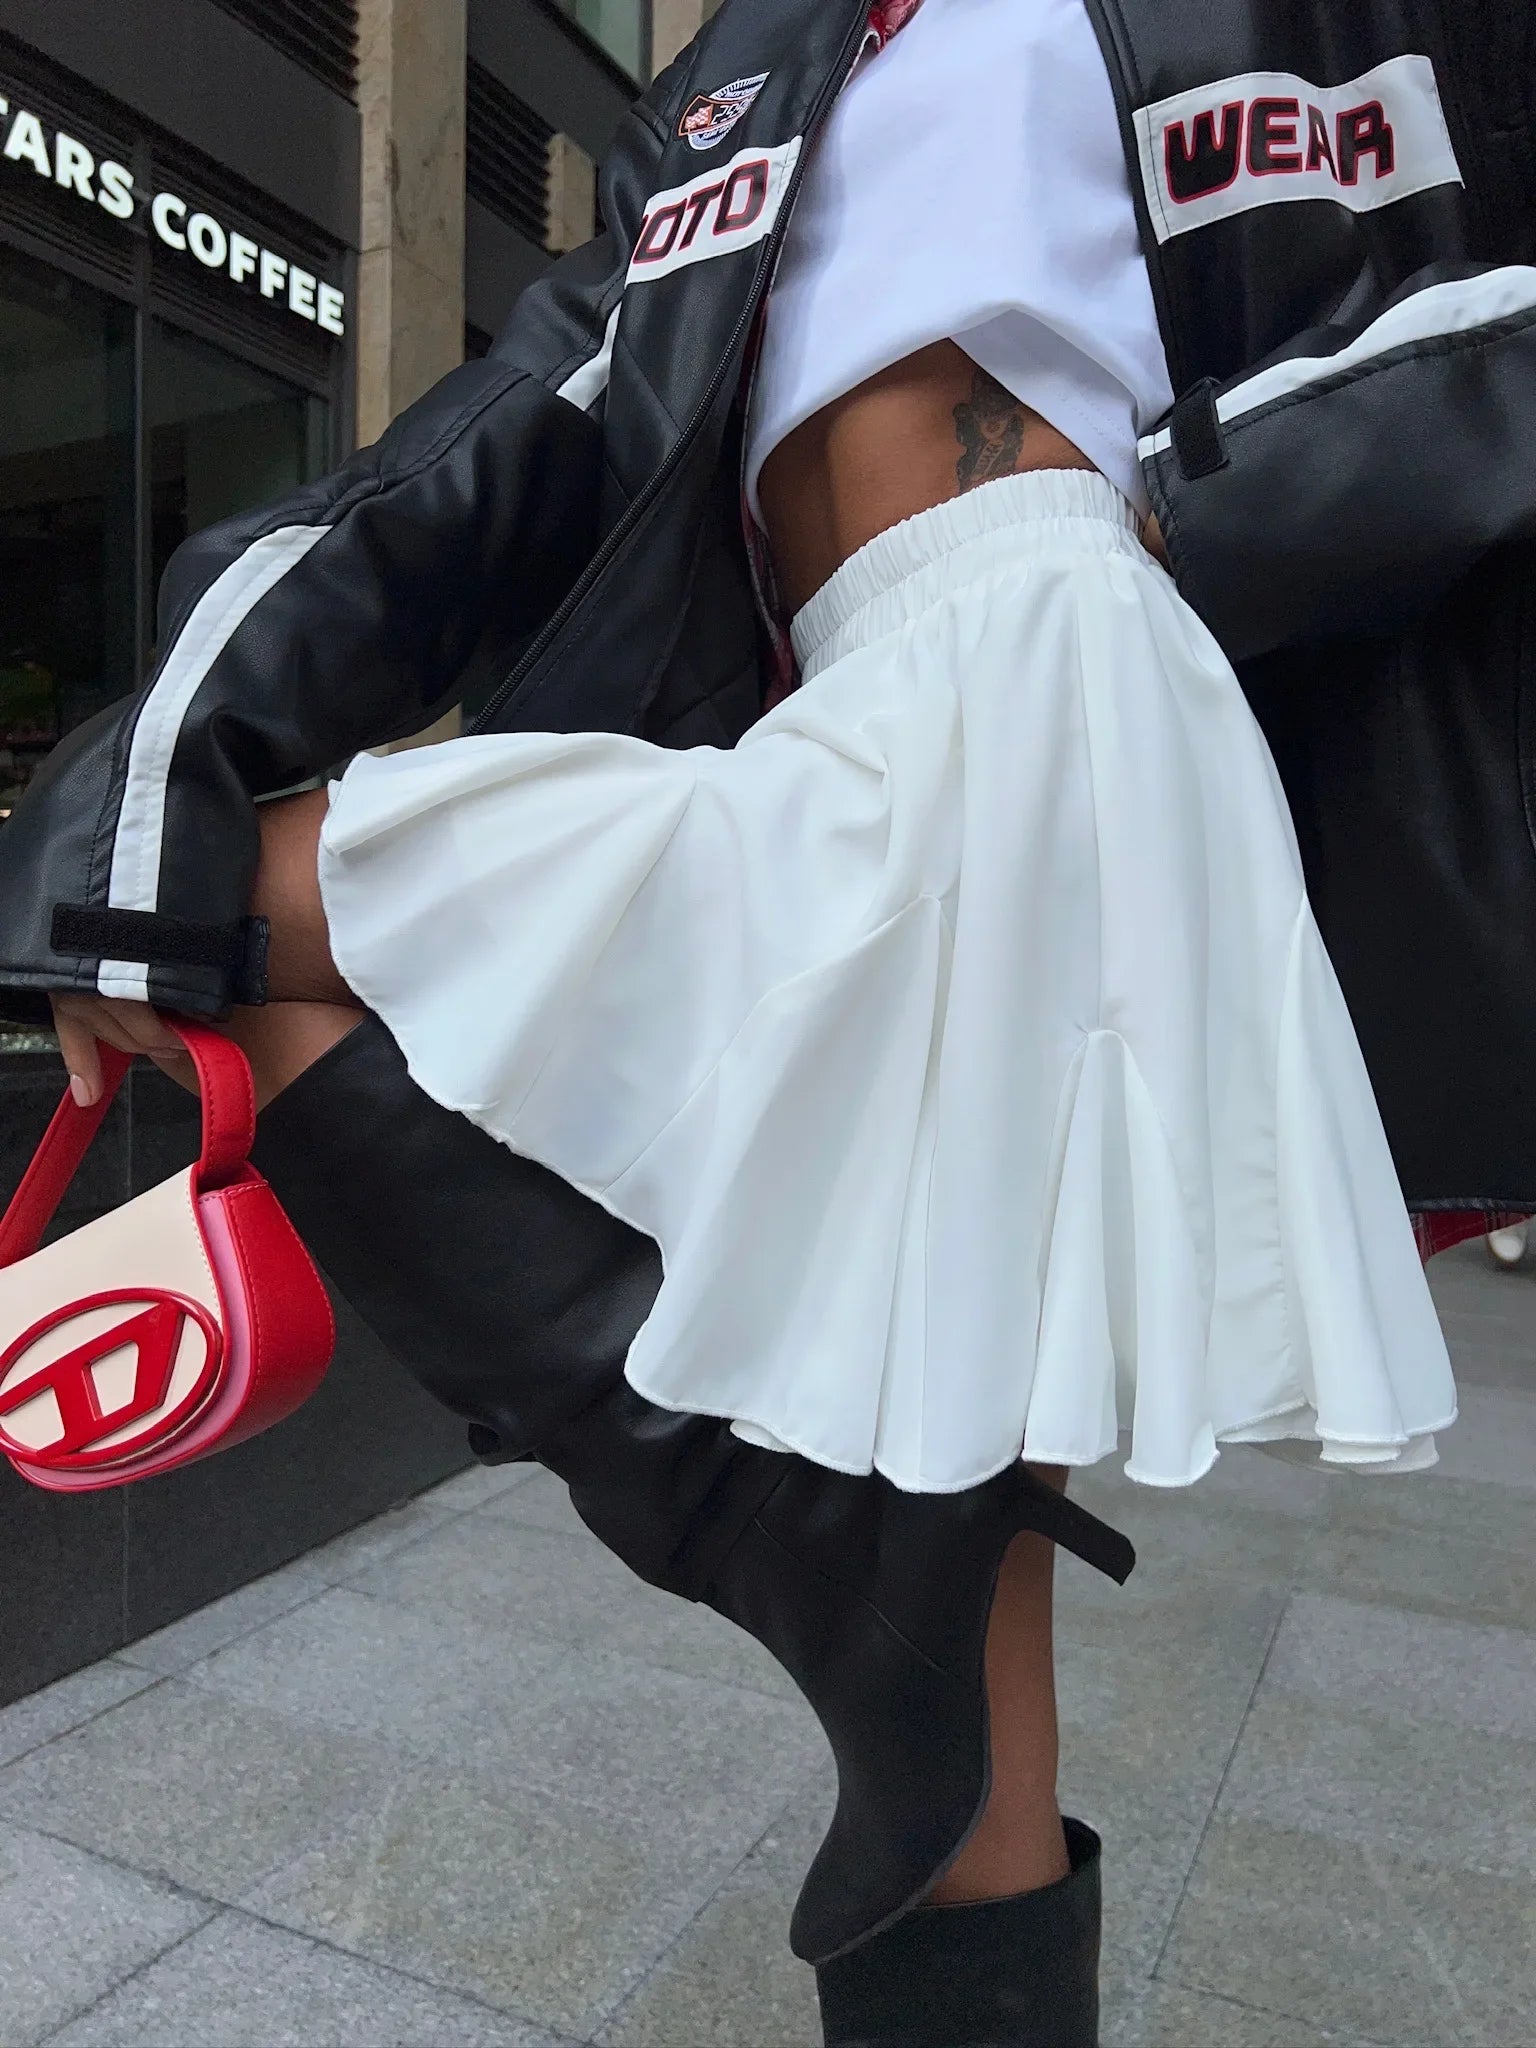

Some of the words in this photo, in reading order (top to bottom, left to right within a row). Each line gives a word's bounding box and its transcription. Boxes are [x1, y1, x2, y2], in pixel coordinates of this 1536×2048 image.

[1164, 97, 1395, 204] WEAR
[151, 192, 345, 336] COFFEE
[632, 159, 769, 264] OTO
